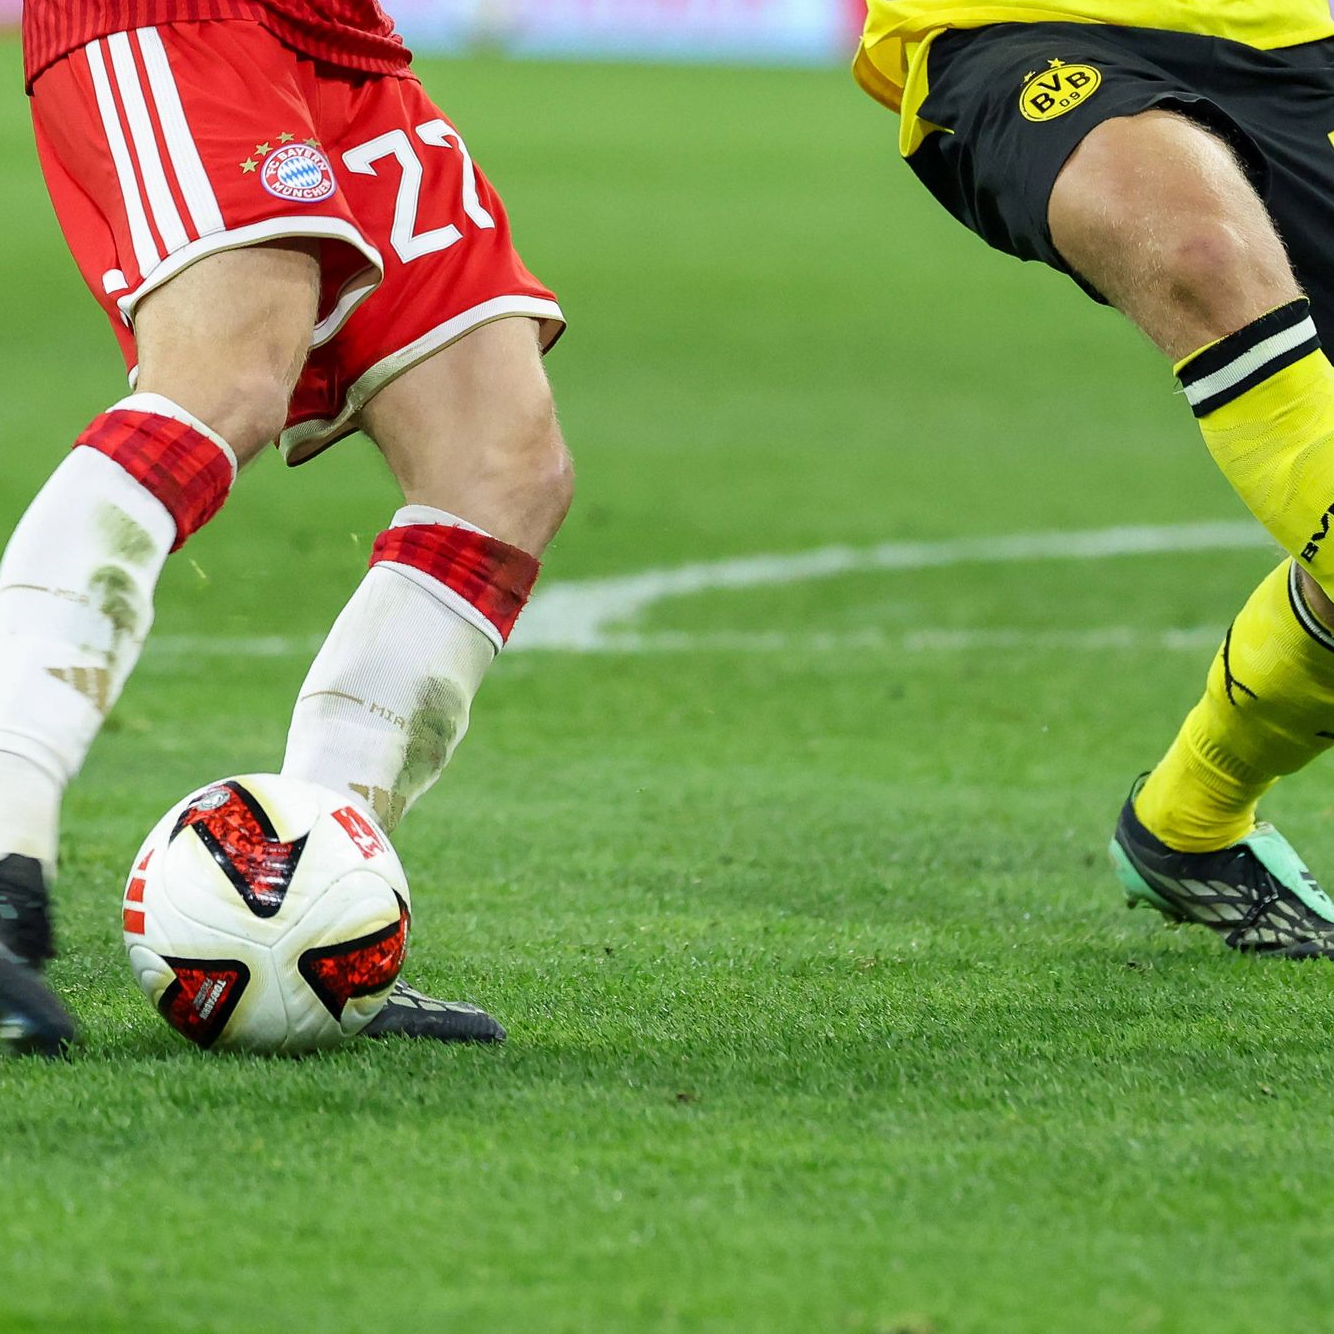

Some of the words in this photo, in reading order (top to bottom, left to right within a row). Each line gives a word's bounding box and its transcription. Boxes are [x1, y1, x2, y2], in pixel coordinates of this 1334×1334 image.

[1029, 71, 1091, 114] BVB
[277, 147, 328, 171] BAYERN
[342, 119, 496, 265] 27
